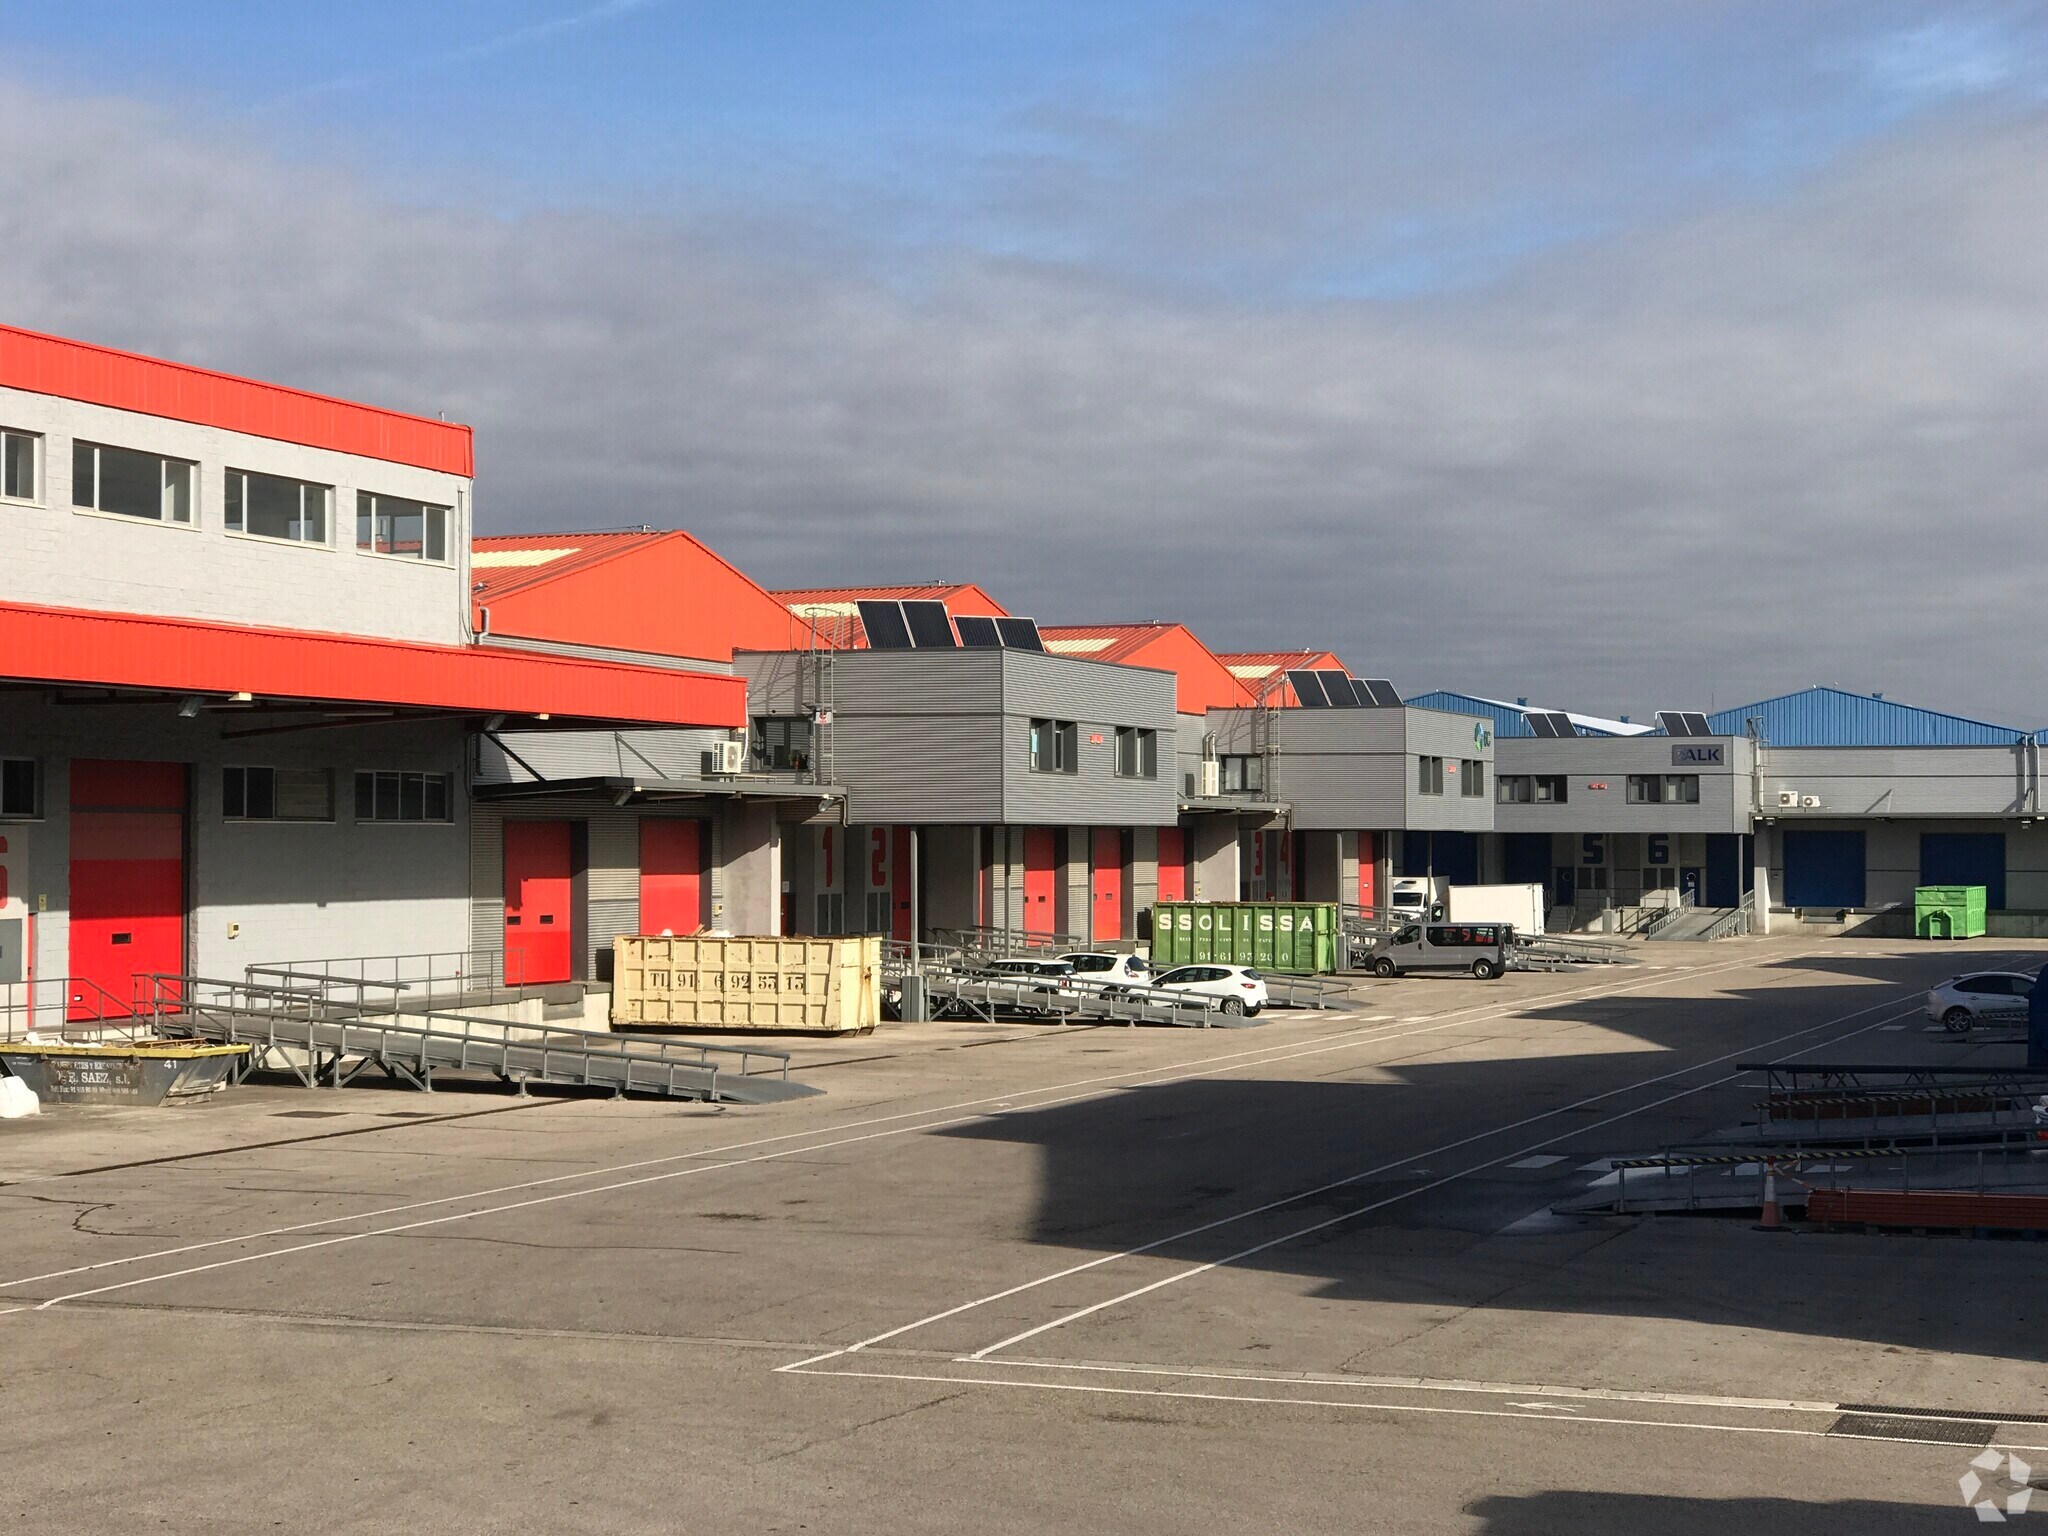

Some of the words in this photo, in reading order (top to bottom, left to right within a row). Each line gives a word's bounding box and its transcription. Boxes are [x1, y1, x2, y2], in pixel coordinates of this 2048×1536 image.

[1682, 748, 1720, 761] ALK
[822, 826, 833, 888] 1
[871, 827, 886, 886] 2
[1254, 831, 1263, 876] 3
[1280, 831, 1289, 875] 4
[1583, 833, 1604, 864] 5
[1648, 833, 1669, 864] 6
[164, 1060, 177, 1069] 41
